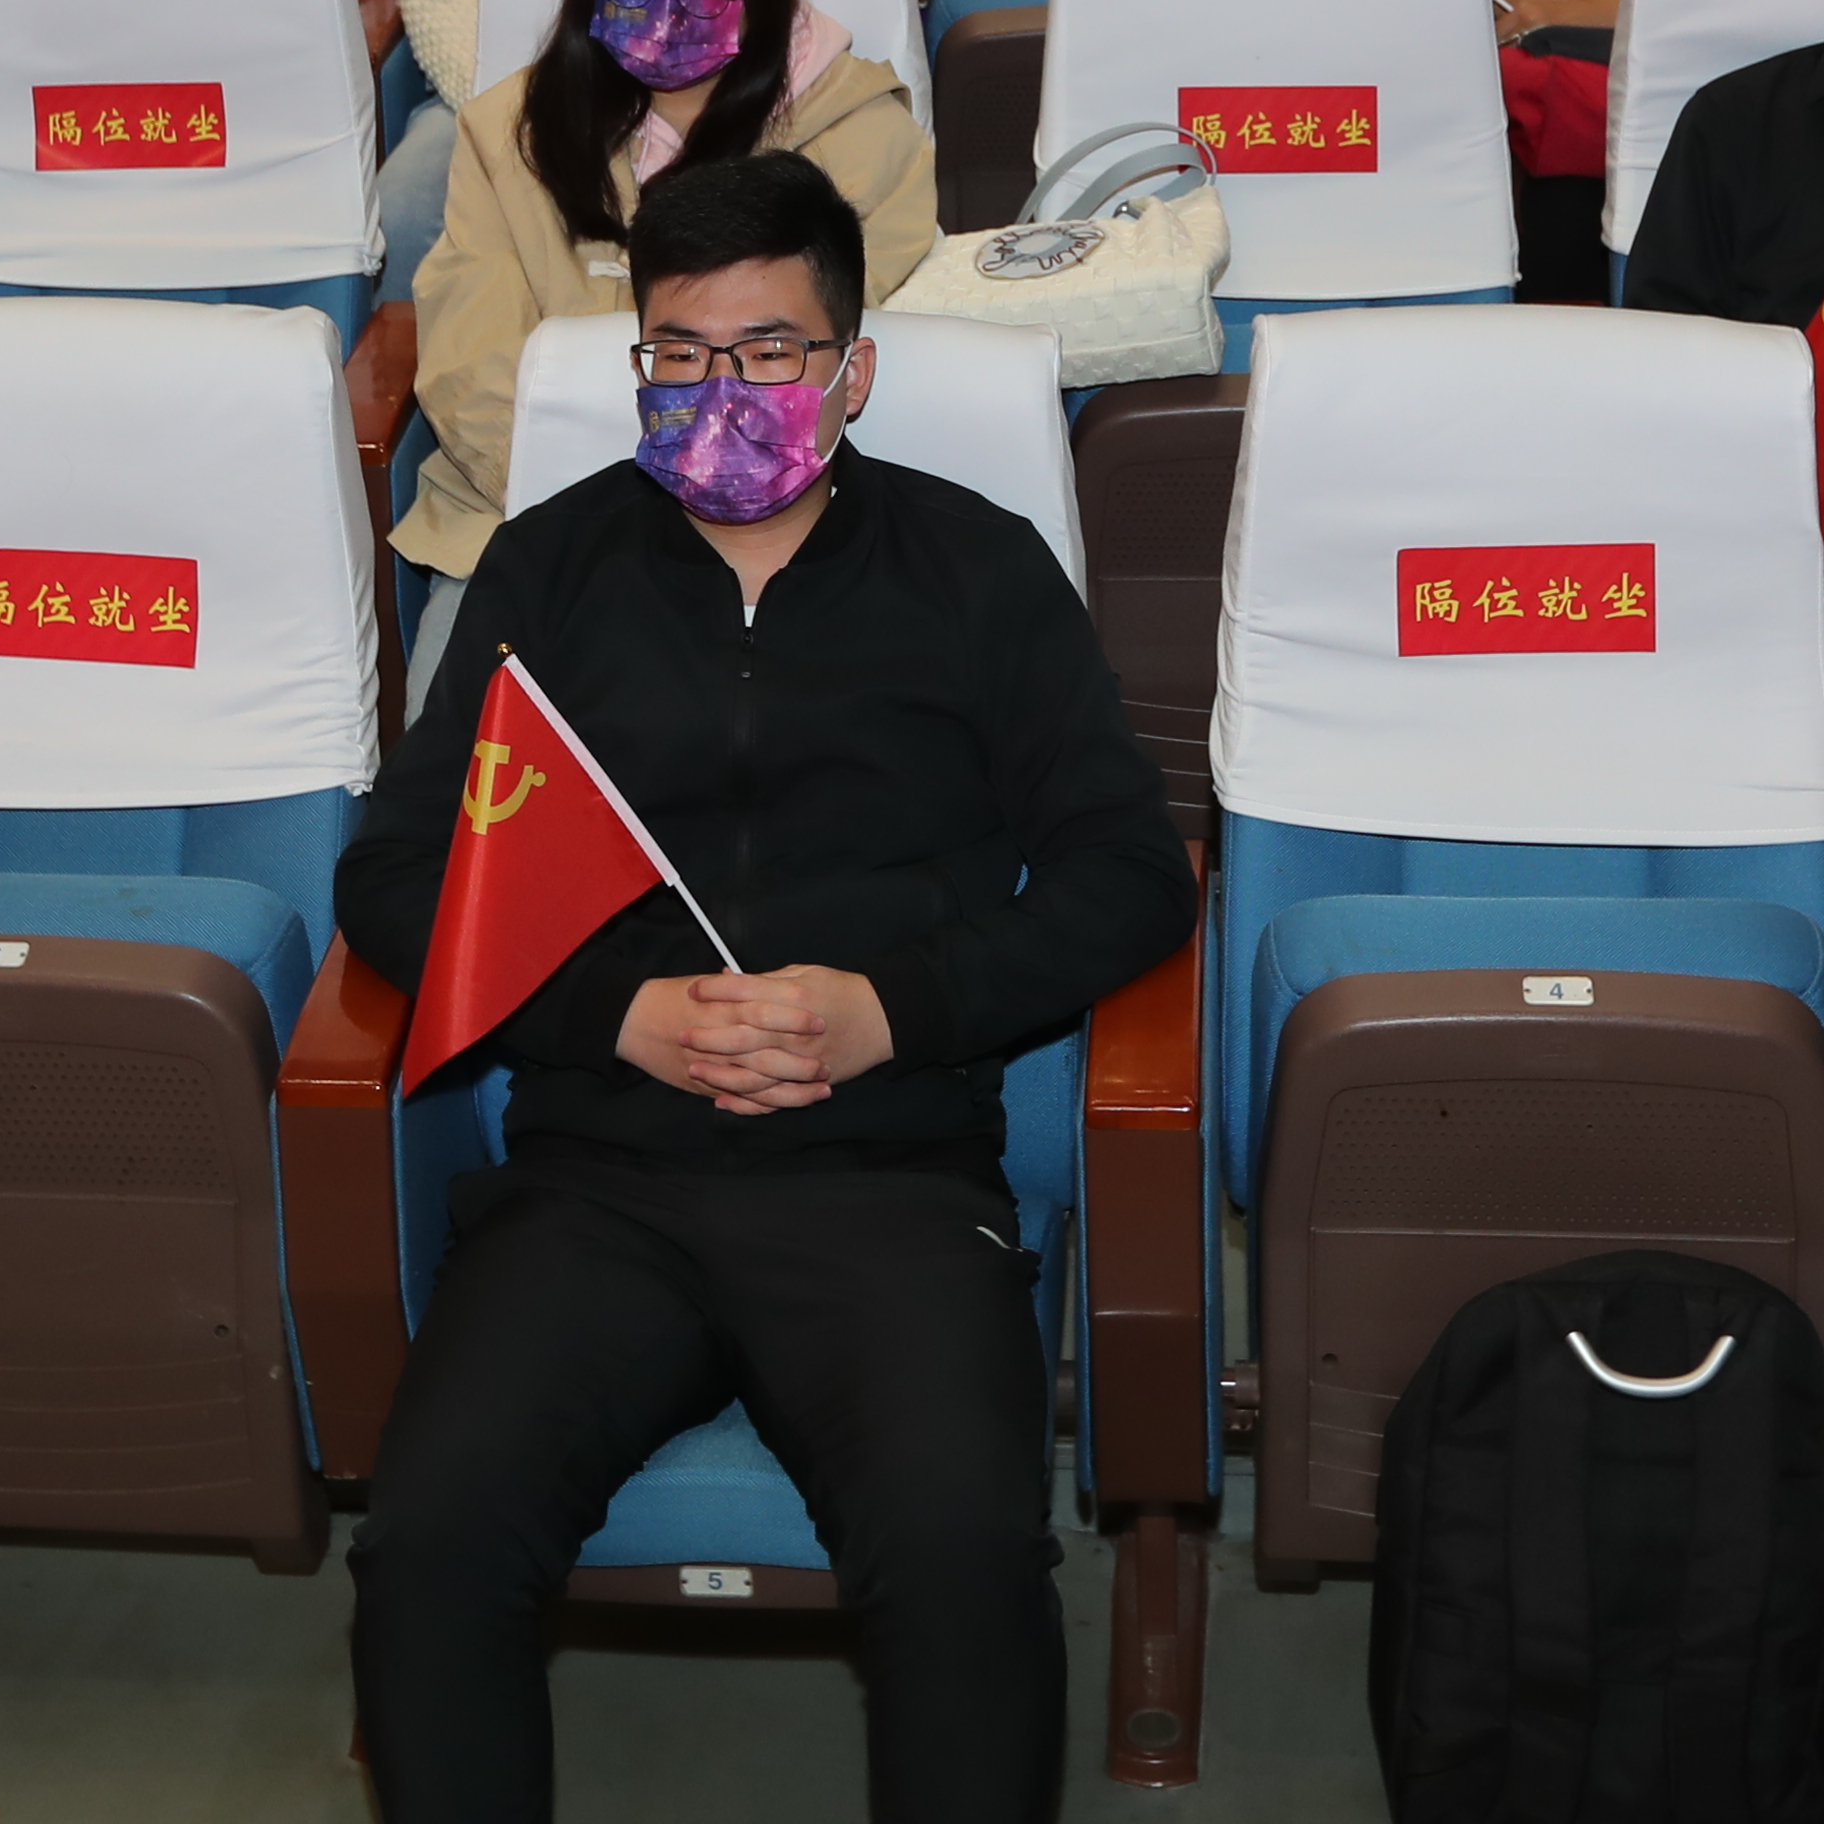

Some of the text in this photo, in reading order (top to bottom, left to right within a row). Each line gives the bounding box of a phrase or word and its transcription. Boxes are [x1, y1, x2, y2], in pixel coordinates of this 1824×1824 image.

[47, 105, 222, 147] 隔位就坐
[1191, 109, 1373, 150] 隔位就坐
[1414, 573, 1649, 623] 隔位就坐
[1549, 982, 1564, 1000] 4
[708, 1571, 723, 1590] 5
